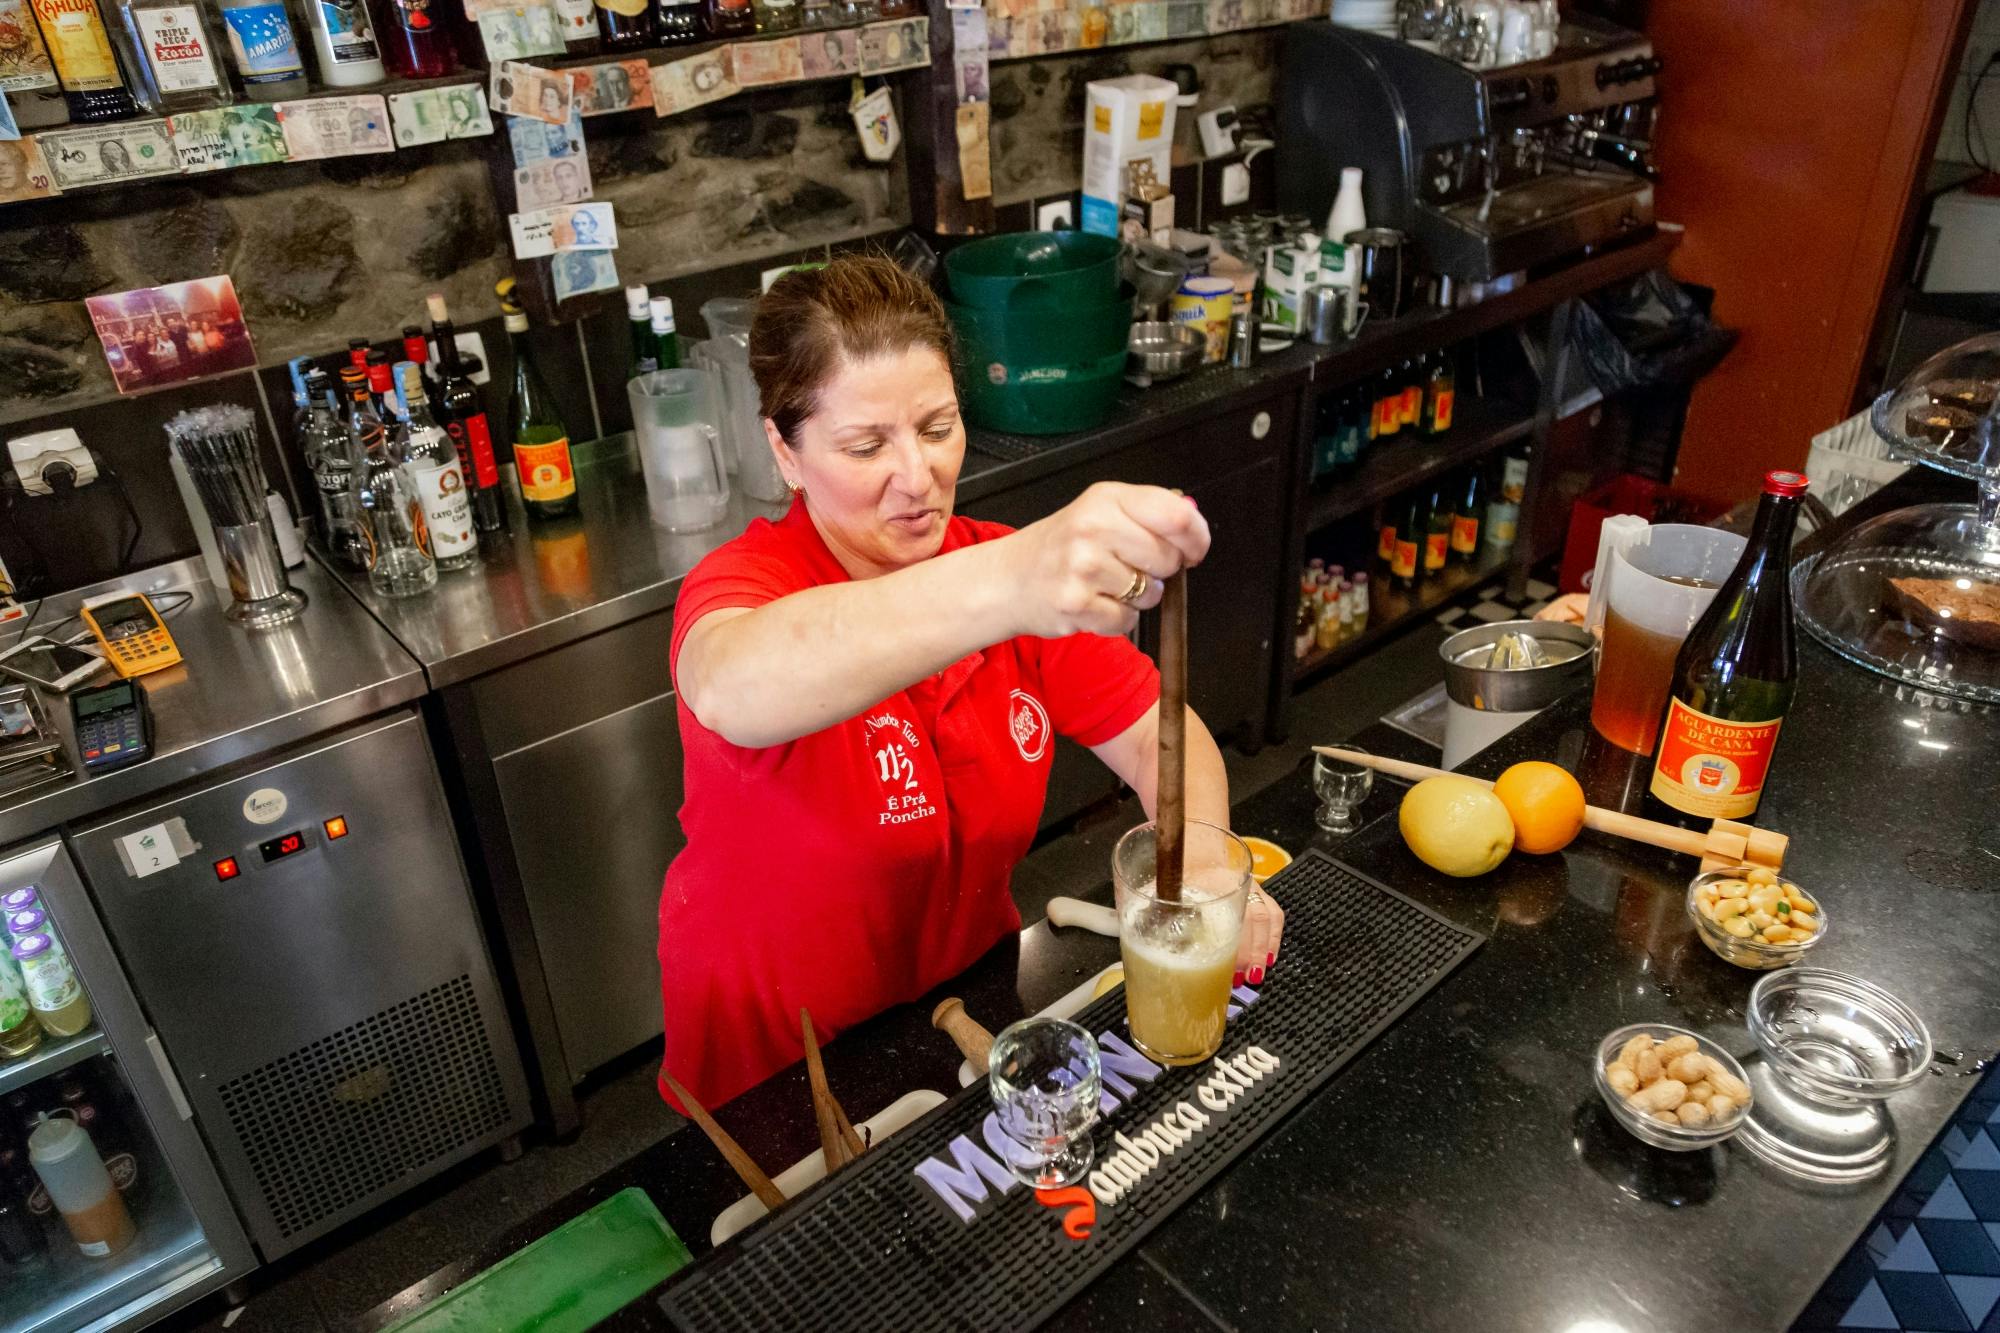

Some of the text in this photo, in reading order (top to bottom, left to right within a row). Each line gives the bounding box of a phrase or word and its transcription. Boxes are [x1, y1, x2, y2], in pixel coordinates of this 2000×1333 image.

[155, 27, 190, 38] TRIPLE
[163, 35, 187, 45] SECO
[32, 175, 49, 189] 20
[1677, 711, 1773, 740] AGUARDENTE
[1688, 728, 1753, 750] DE CANA
[887, 792, 927, 811] É Prá
[879, 806, 936, 825] Poncha
[152, 857, 160, 867] 2
[1197, 1045, 1281, 1112] extra
